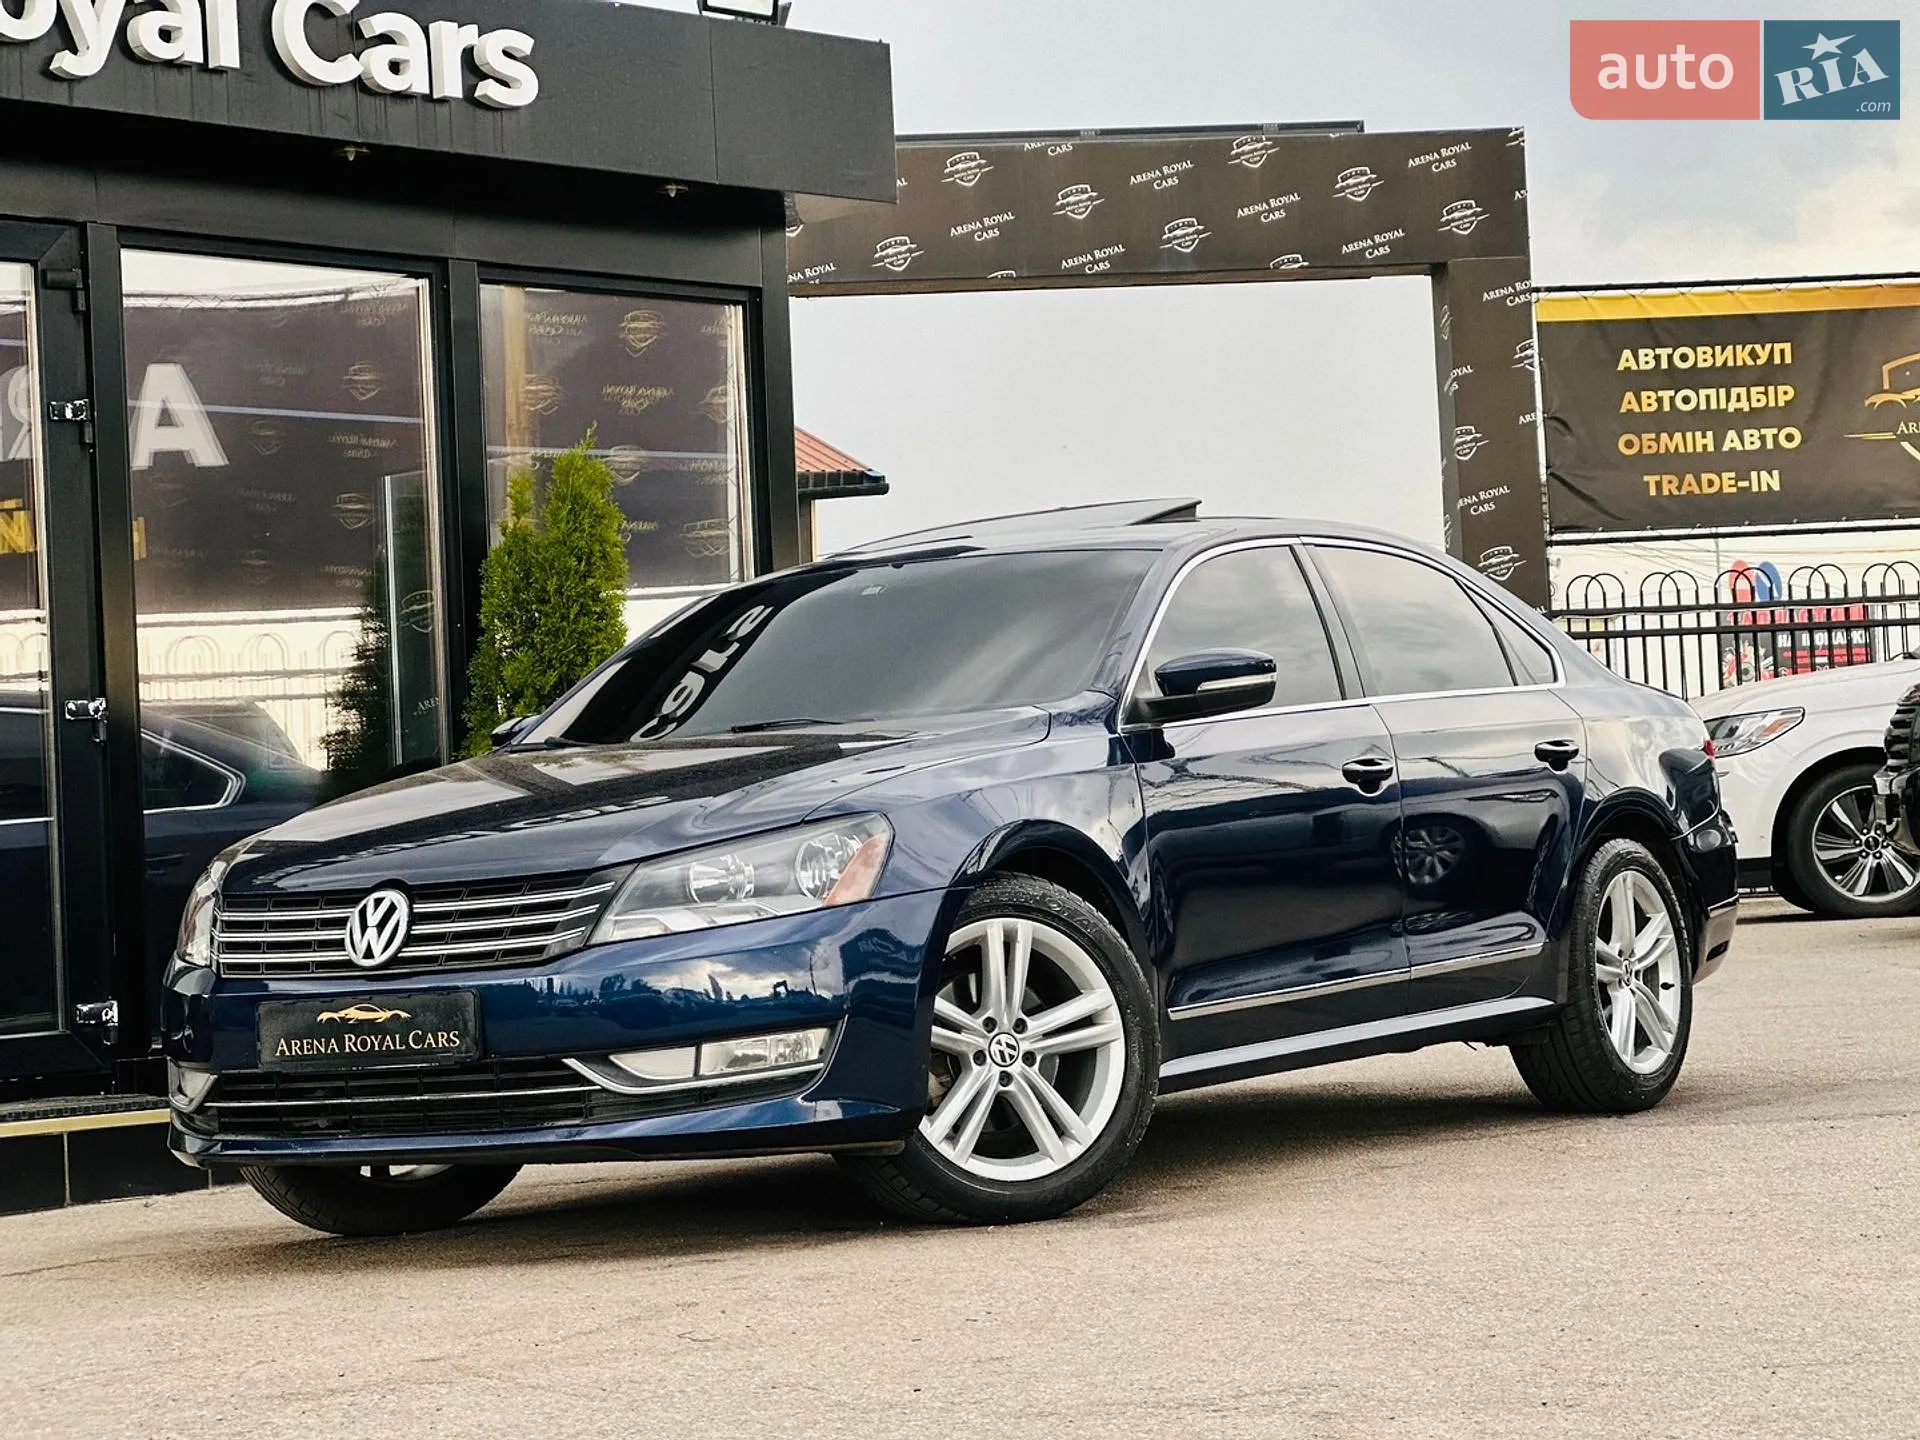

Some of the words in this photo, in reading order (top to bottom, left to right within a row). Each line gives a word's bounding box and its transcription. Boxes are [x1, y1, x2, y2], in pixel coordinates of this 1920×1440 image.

[271, 0, 540, 109] Cars
[1047, 142, 1073, 156] CARS
[1407, 151, 1440, 168] ARENA
[1440, 141, 1472, 158] ROYAL
[1129, 168, 1162, 185] ARENA
[1162, 159, 1194, 176] ROYAL
[1431, 158, 1457, 172] CARS
[1153, 176, 1179, 190] CARS
[1236, 201, 1269, 218] ARENA
[1269, 191, 1301, 209] ROYAL
[1260, 208, 1286, 223] CARS
[950, 220, 982, 237] ARENA
[983, 211, 1015, 227] ROYAL
[974, 227, 1000, 242] CARS
[1341, 238, 1373, 255] ARENA
[1374, 228, 1406, 244] ROYAL
[1365, 244, 1391, 259] CARS
[1061, 253, 1093, 270] ARENA
[1095, 243, 1126, 259] ROYAL
[1085, 259, 1111, 274] CARS
[804, 262, 837, 278] ROYAL
[1482, 286, 1515, 301] ARENA
[1617, 342, 1792, 371] АВТОВИКУП
[1619, 385, 1795, 413] АВТОПІДБІР
[1618, 431, 1715, 456] ОБМІН
[1721, 426, 1802, 452] АВТО
[1479, 485, 1510, 500] ROYAL
[1643, 470, 1780, 496] TRADE-IN
[1470, 501, 1496, 516] CARS
[275, 1036, 339, 1056] ARENA
[344, 1034, 405, 1052] ROYAL
[409, 1030, 460, 1049] CARS
